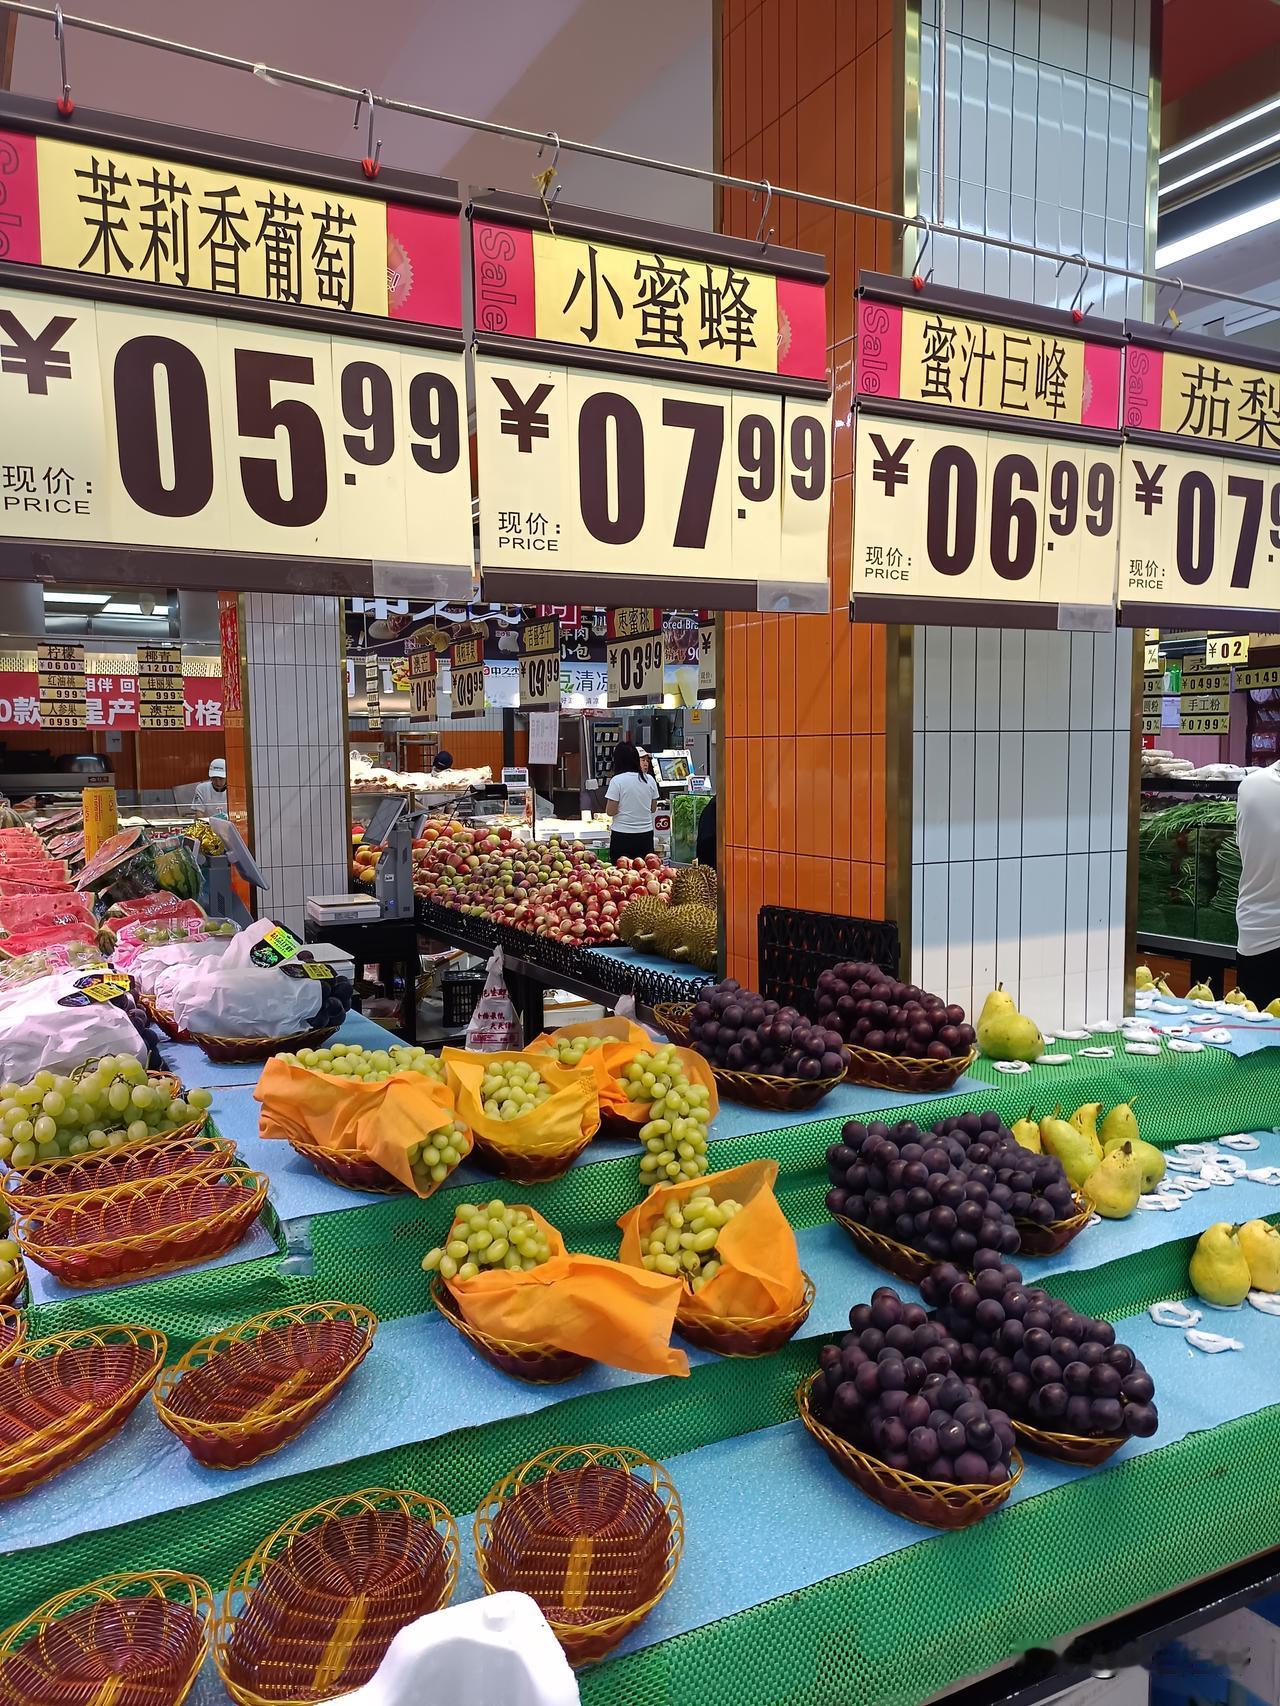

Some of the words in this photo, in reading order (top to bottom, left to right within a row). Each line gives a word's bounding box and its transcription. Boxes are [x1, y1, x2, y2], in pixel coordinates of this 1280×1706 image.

[74, 155, 356, 311] 茉莉香葡萄
[480, 228, 516, 332] Sale
[563, 244, 758, 362] 小蜜蜂
[861, 305, 889, 394] Sale
[920, 316, 1068, 419] 蜜汁巨峰
[1128, 351, 1149, 426] Sale
[3, 496, 91, 515] PRICE
[498, 536, 559, 552] PRICE
[865, 568, 909, 581] PRICE
[1129, 579, 1164, 590] PRICE
[1188, 699, 1220, 711] 手工粉
